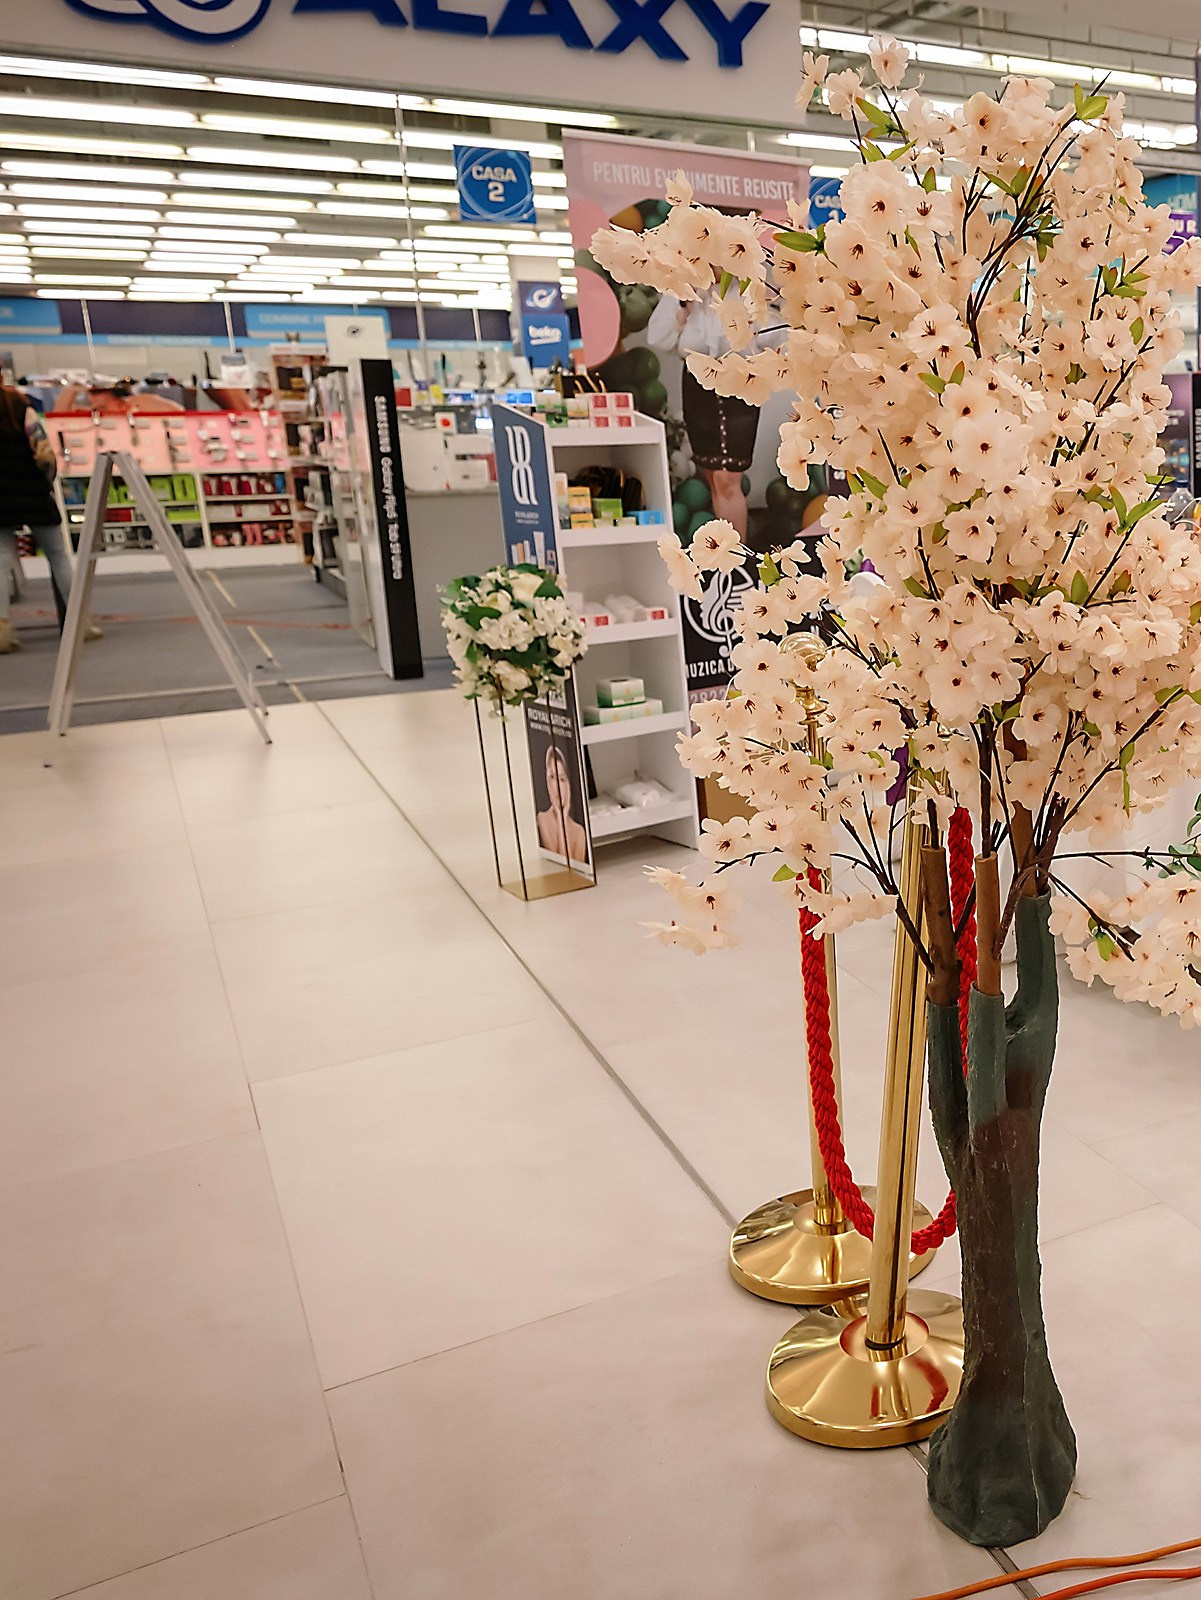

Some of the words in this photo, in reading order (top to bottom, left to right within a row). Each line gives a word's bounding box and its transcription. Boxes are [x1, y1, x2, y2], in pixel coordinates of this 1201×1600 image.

[472, 165, 516, 184] CASA
[593, 161, 651, 188] PENTRU
[744, 178, 795, 201] REUSITE
[488, 182, 504, 202] 2
